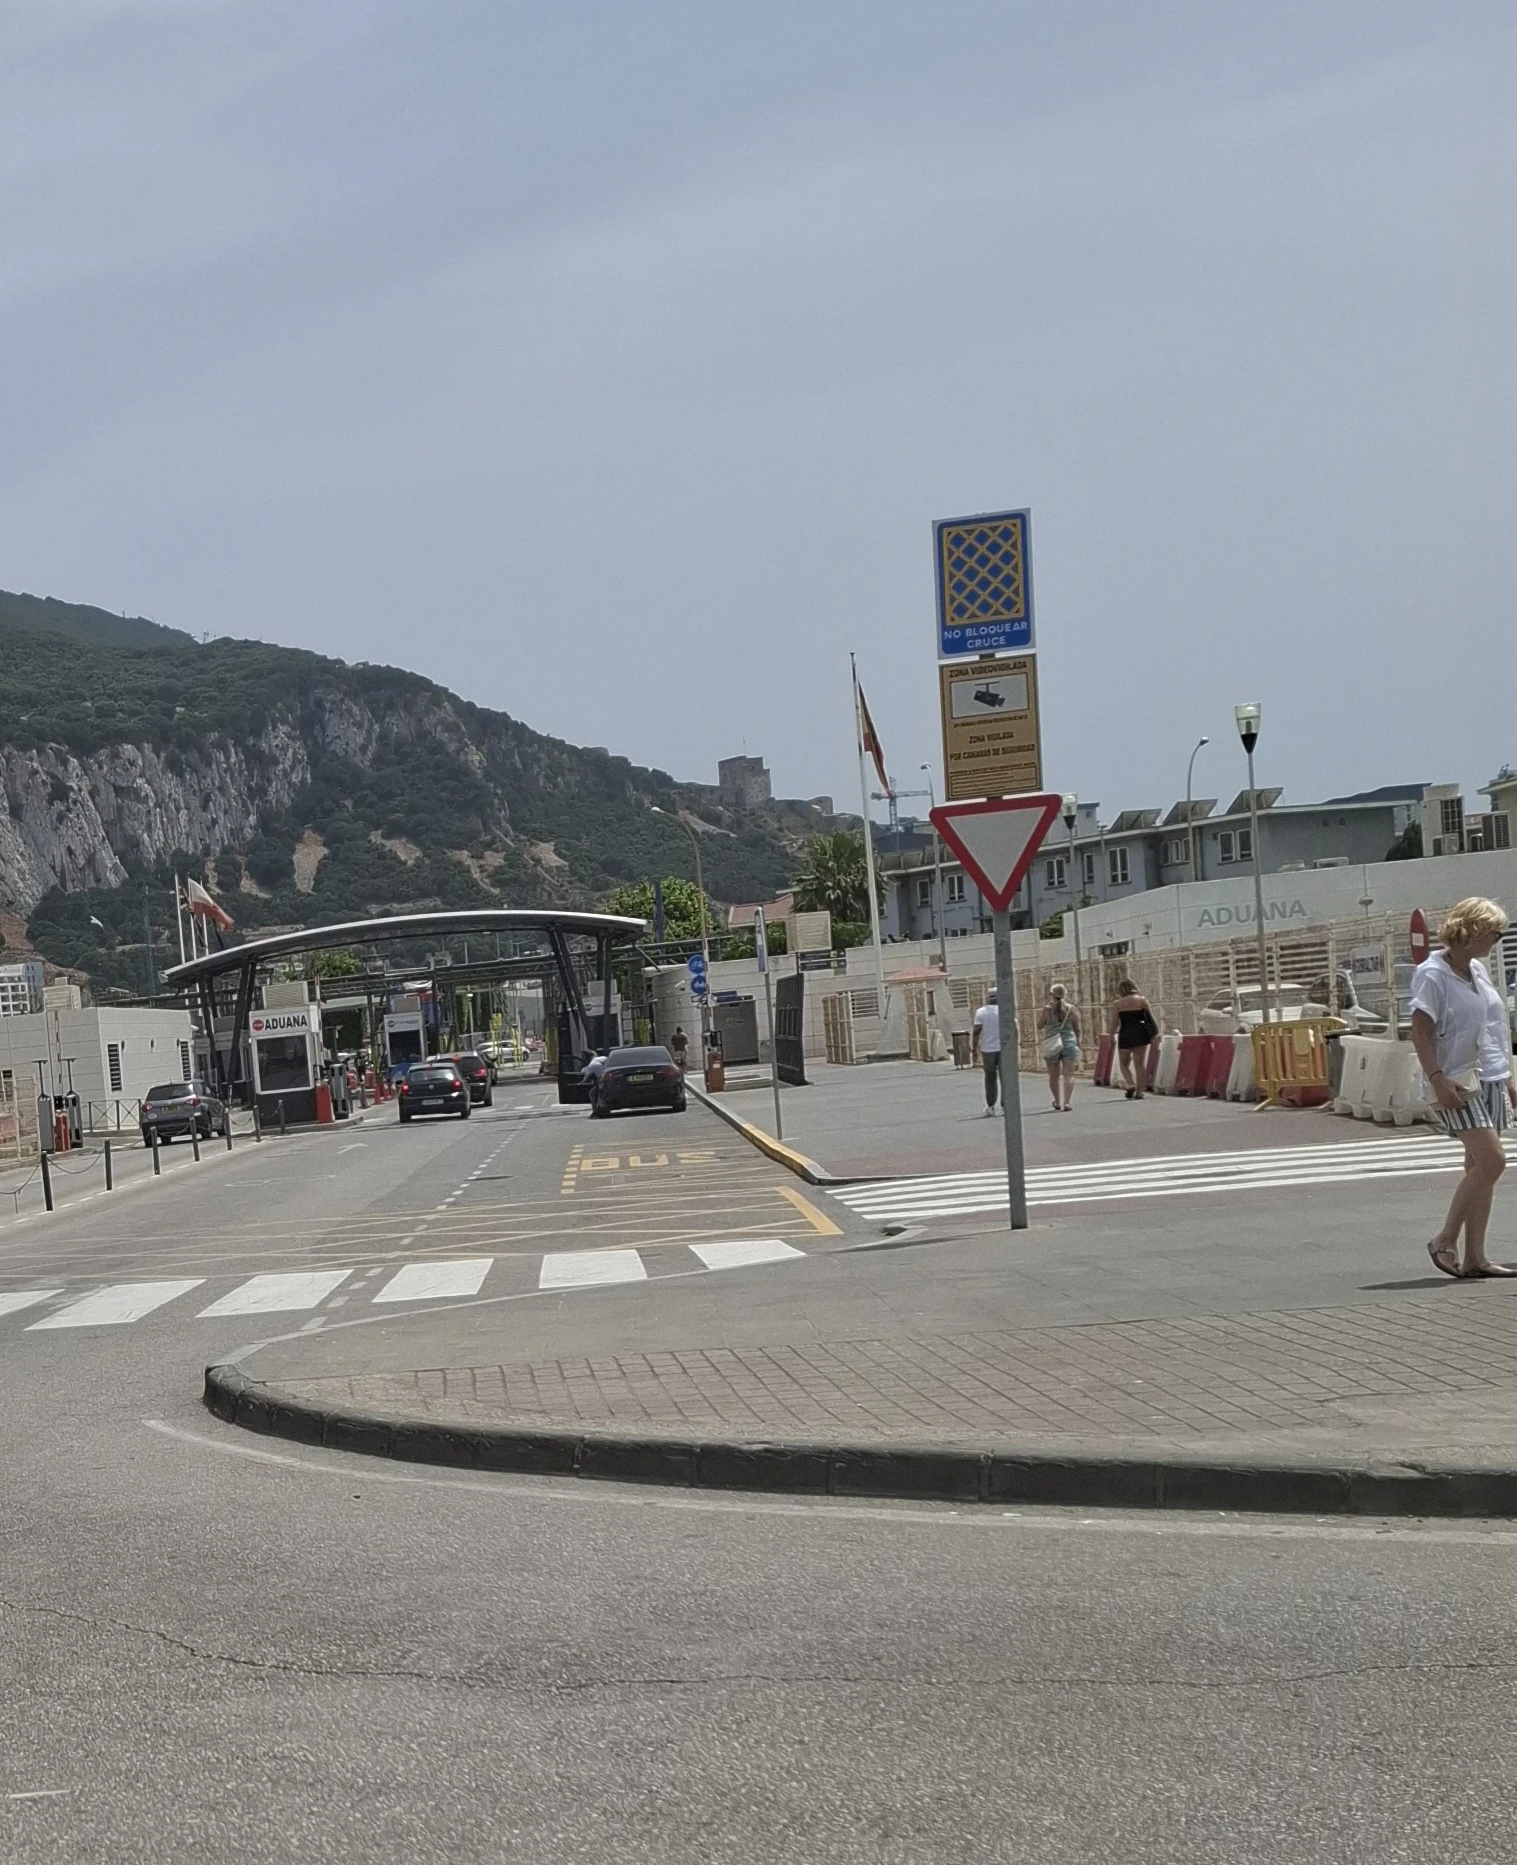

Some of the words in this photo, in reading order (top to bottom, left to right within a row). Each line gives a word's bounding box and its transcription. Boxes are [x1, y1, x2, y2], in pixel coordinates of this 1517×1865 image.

[944, 629, 961, 640] NO
[965, 621, 1028, 637] BLOQUEAR
[966, 635, 1007, 648] CRUCE
[1197, 899, 1307, 928] ADUANA
[265, 1014, 308, 1031] ADUANA
[580, 1151, 716, 1171] BUS
